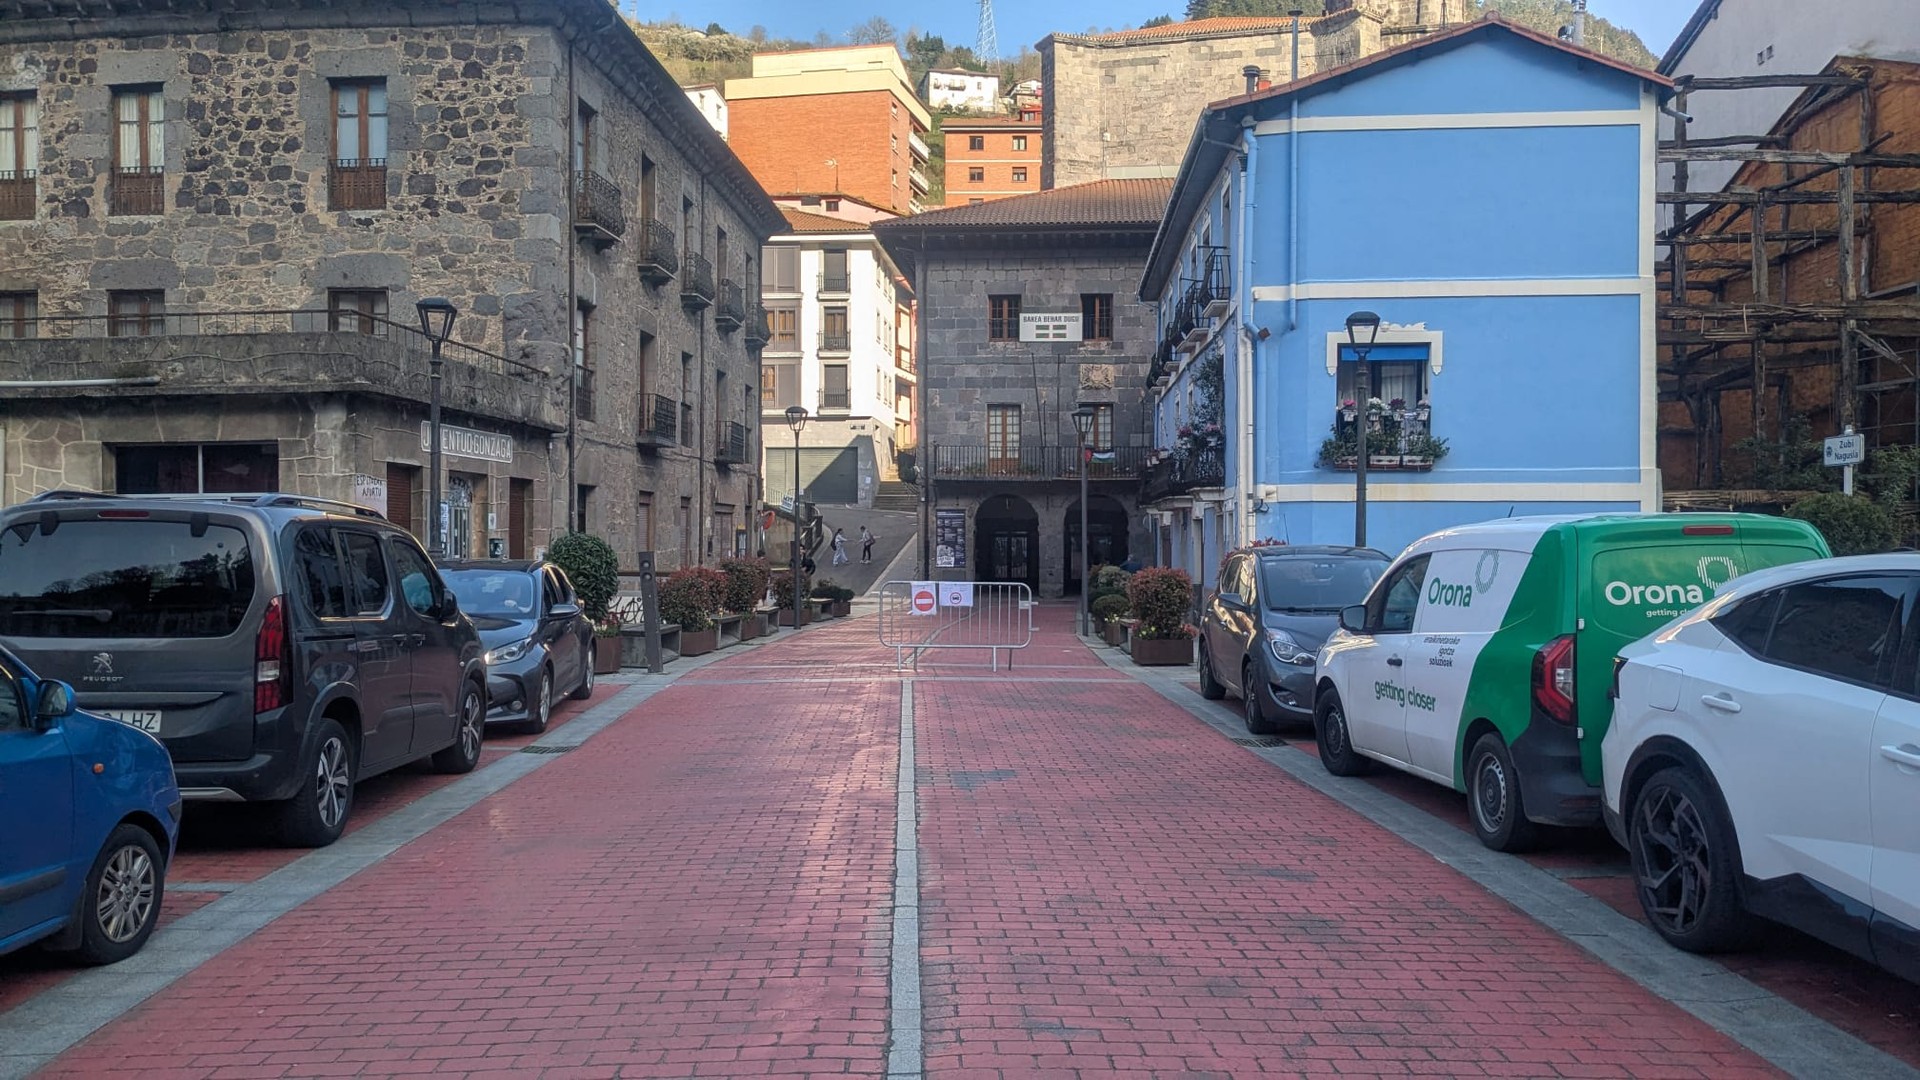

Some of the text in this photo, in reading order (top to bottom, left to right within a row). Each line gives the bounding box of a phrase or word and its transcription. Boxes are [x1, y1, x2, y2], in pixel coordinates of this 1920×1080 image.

[423, 426, 512, 459] JENTUD GONZAGA
[1839, 439, 1854, 449] Zubi
[1834, 450, 1859, 461] Nagusia
[1428, 577, 1472, 607] Orona
[1605, 581, 1704, 606] Orona
[1646, 608, 1678, 618] getting
[1429, 656, 1453, 668] soluzioak
[1374, 679, 1436, 712] getting closer
